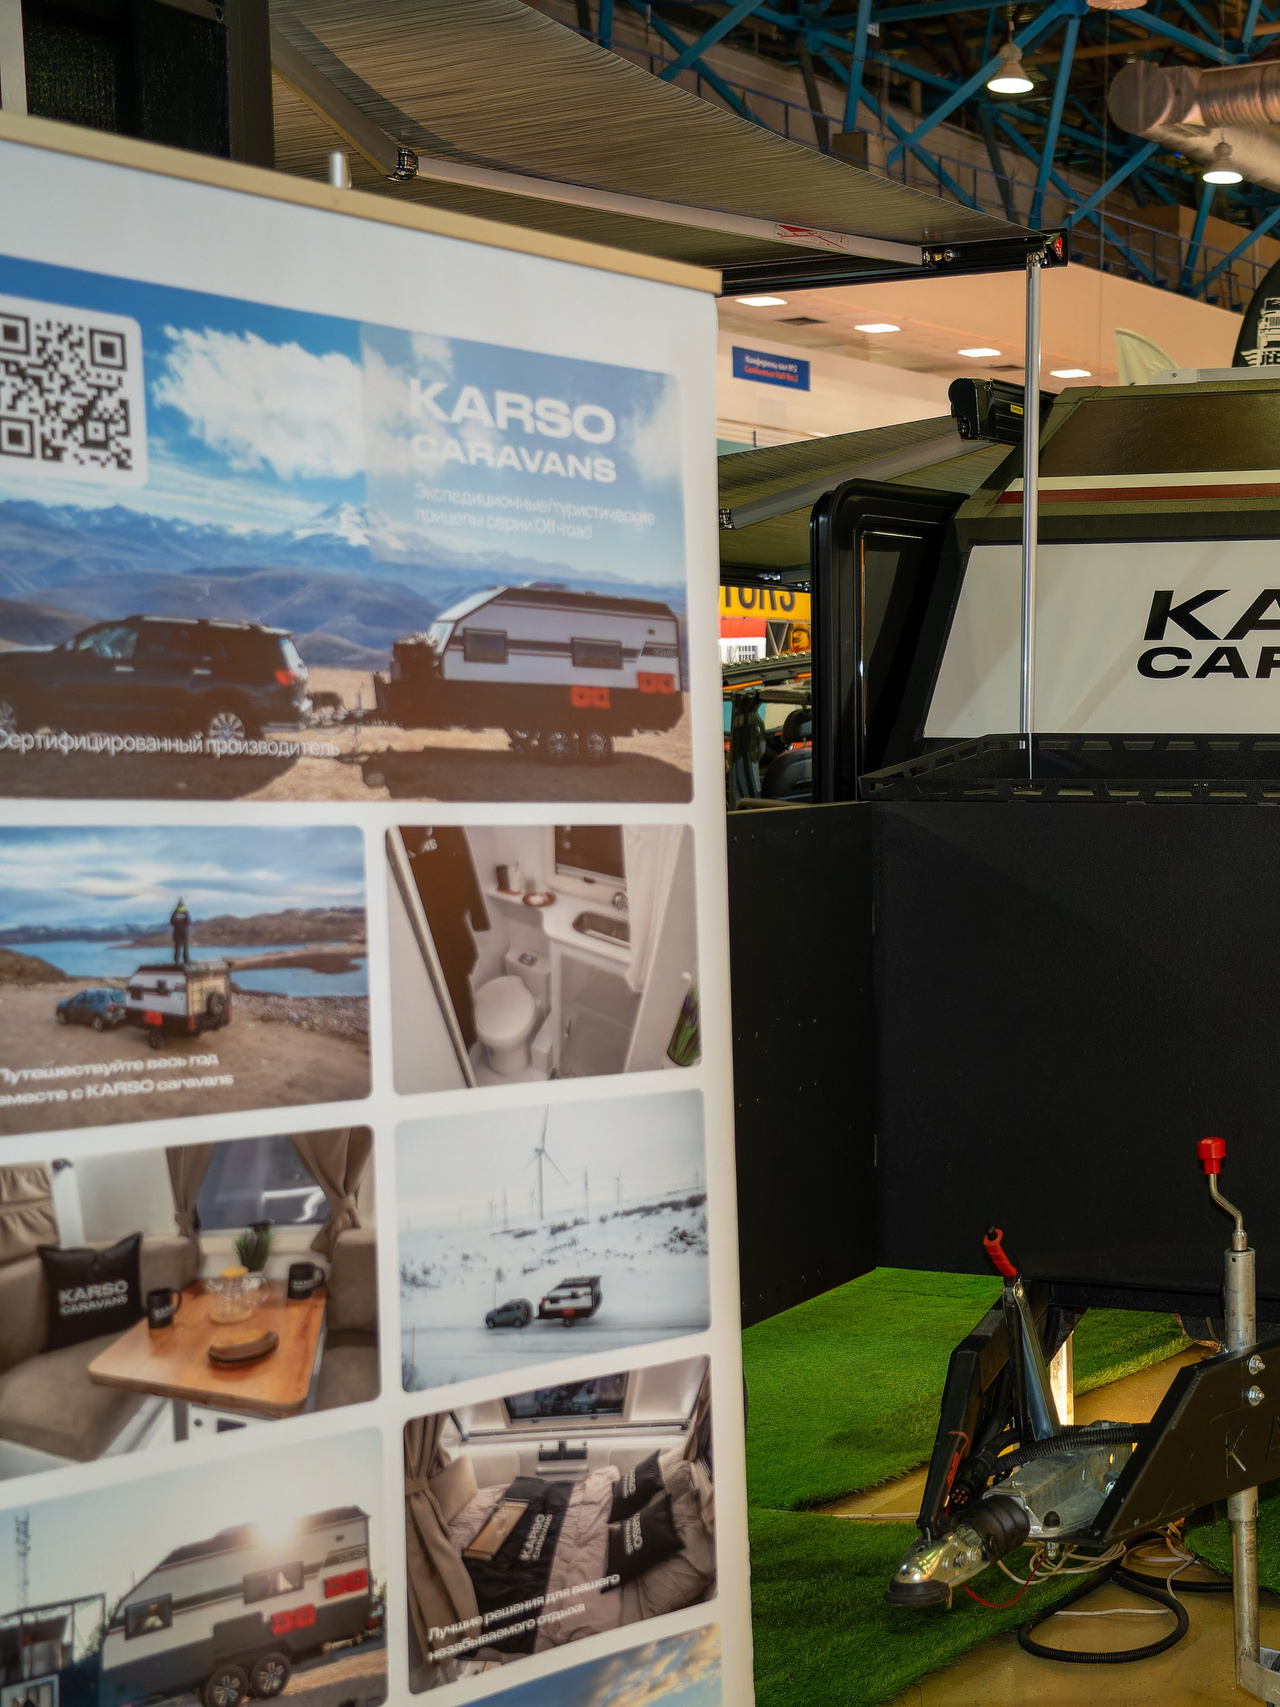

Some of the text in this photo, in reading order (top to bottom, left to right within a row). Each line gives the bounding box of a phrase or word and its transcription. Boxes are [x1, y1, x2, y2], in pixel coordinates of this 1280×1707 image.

[409, 377, 616, 444] KARSO
[410, 434, 617, 483] CARAVANS
[486, 514, 533, 534] серии
[206, 738, 341, 759] производитель
[146, 1057, 187, 1070] весь
[189, 1053, 219, 1067] год
[86, 1079, 154, 1099] KARSO
[156, 1073, 235, 1091] caravans
[58, 1279, 129, 1304] KARSO
[428, 1573, 621, 1642] Лучшие решения для вашего
[427, 1601, 586, 1663] незабываемого отдыха
